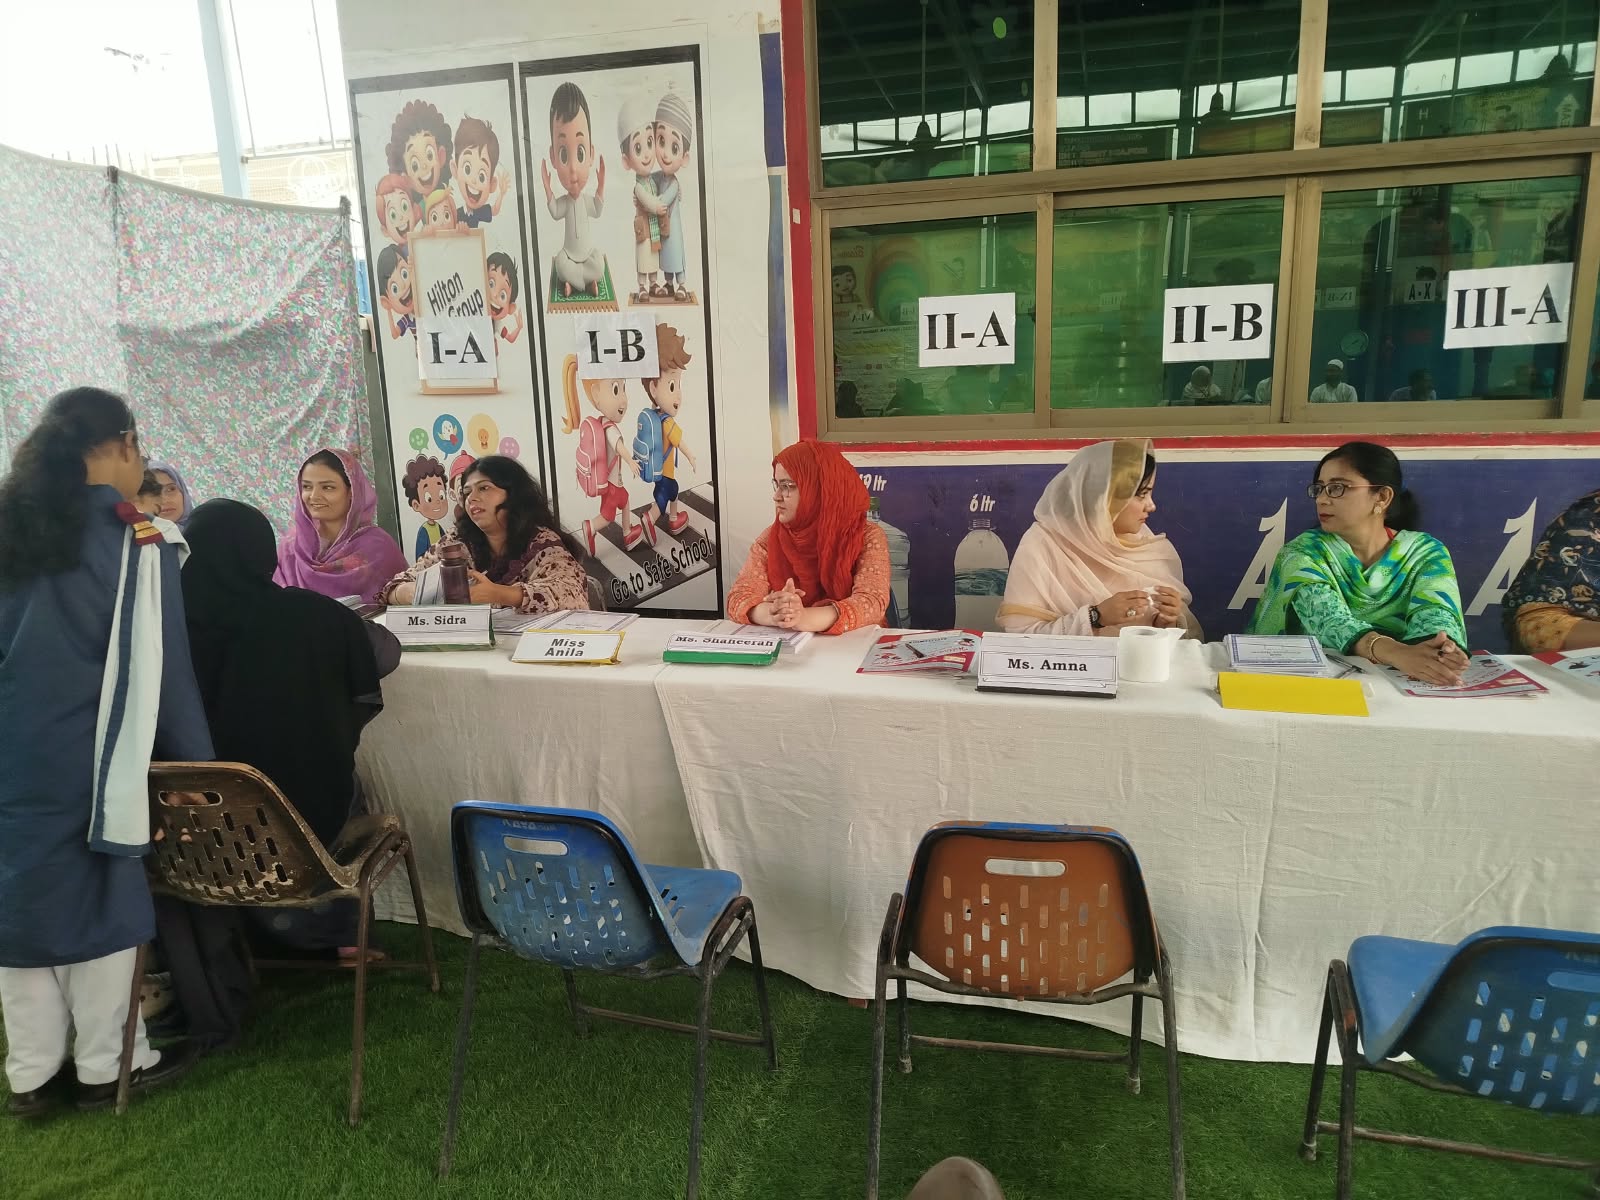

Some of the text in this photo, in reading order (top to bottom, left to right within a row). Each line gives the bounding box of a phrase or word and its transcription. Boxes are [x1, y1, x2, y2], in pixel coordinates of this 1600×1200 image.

[427, 272, 464, 316] Hilton
[1451, 283, 1562, 330] III-A
[923, 310, 1010, 350] II-A
[1169, 303, 1263, 344] II-B
[427, 331, 488, 364] I-A
[585, 329, 646, 364] I-B
[872, 474, 888, 491] ltr
[969, 493, 996, 512] 6 ltr
[611, 528, 713, 604] Go to Safe School
[408, 615, 467, 626] Ms. Sidra
[544, 647, 584, 657] Anila
[551, 638, 586, 648] Miss
[1007, 658, 1088, 672] Ms. Amna
